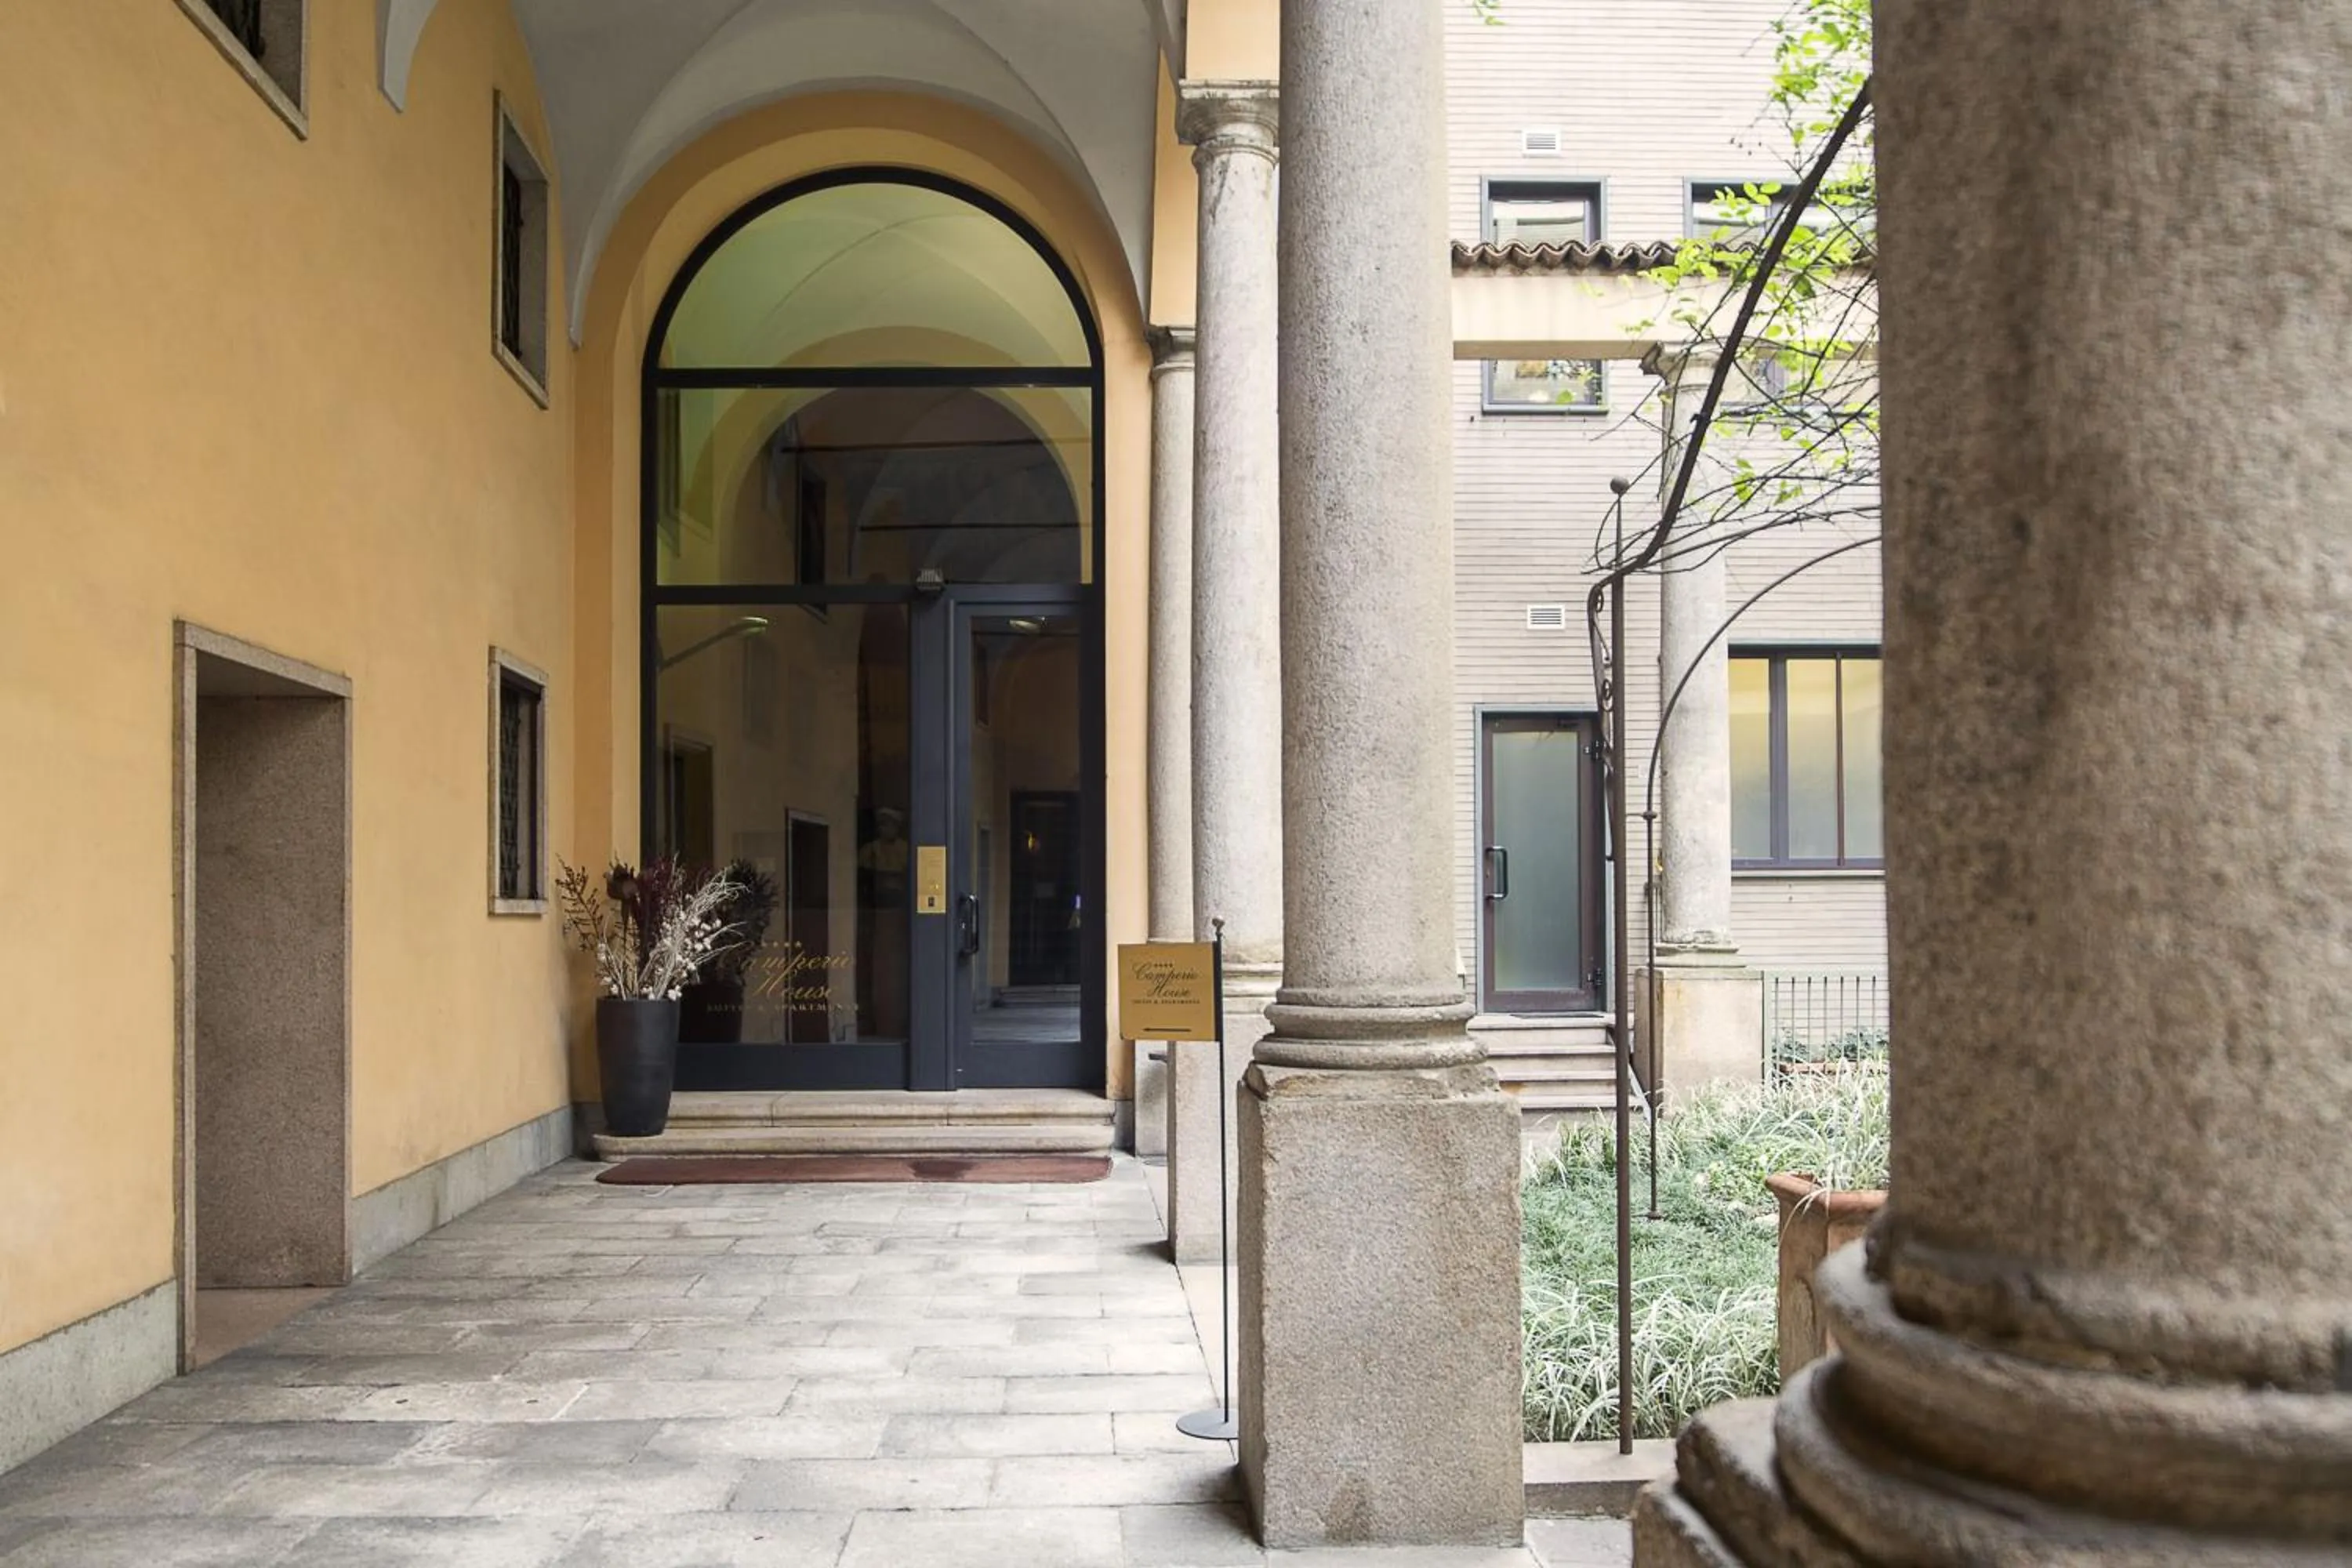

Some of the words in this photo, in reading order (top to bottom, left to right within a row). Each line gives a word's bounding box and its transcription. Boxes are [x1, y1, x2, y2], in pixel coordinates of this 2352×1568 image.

[1132, 962, 1200, 981] Camperio
[751, 974, 833, 999] House
[1146, 979, 1192, 997] House
